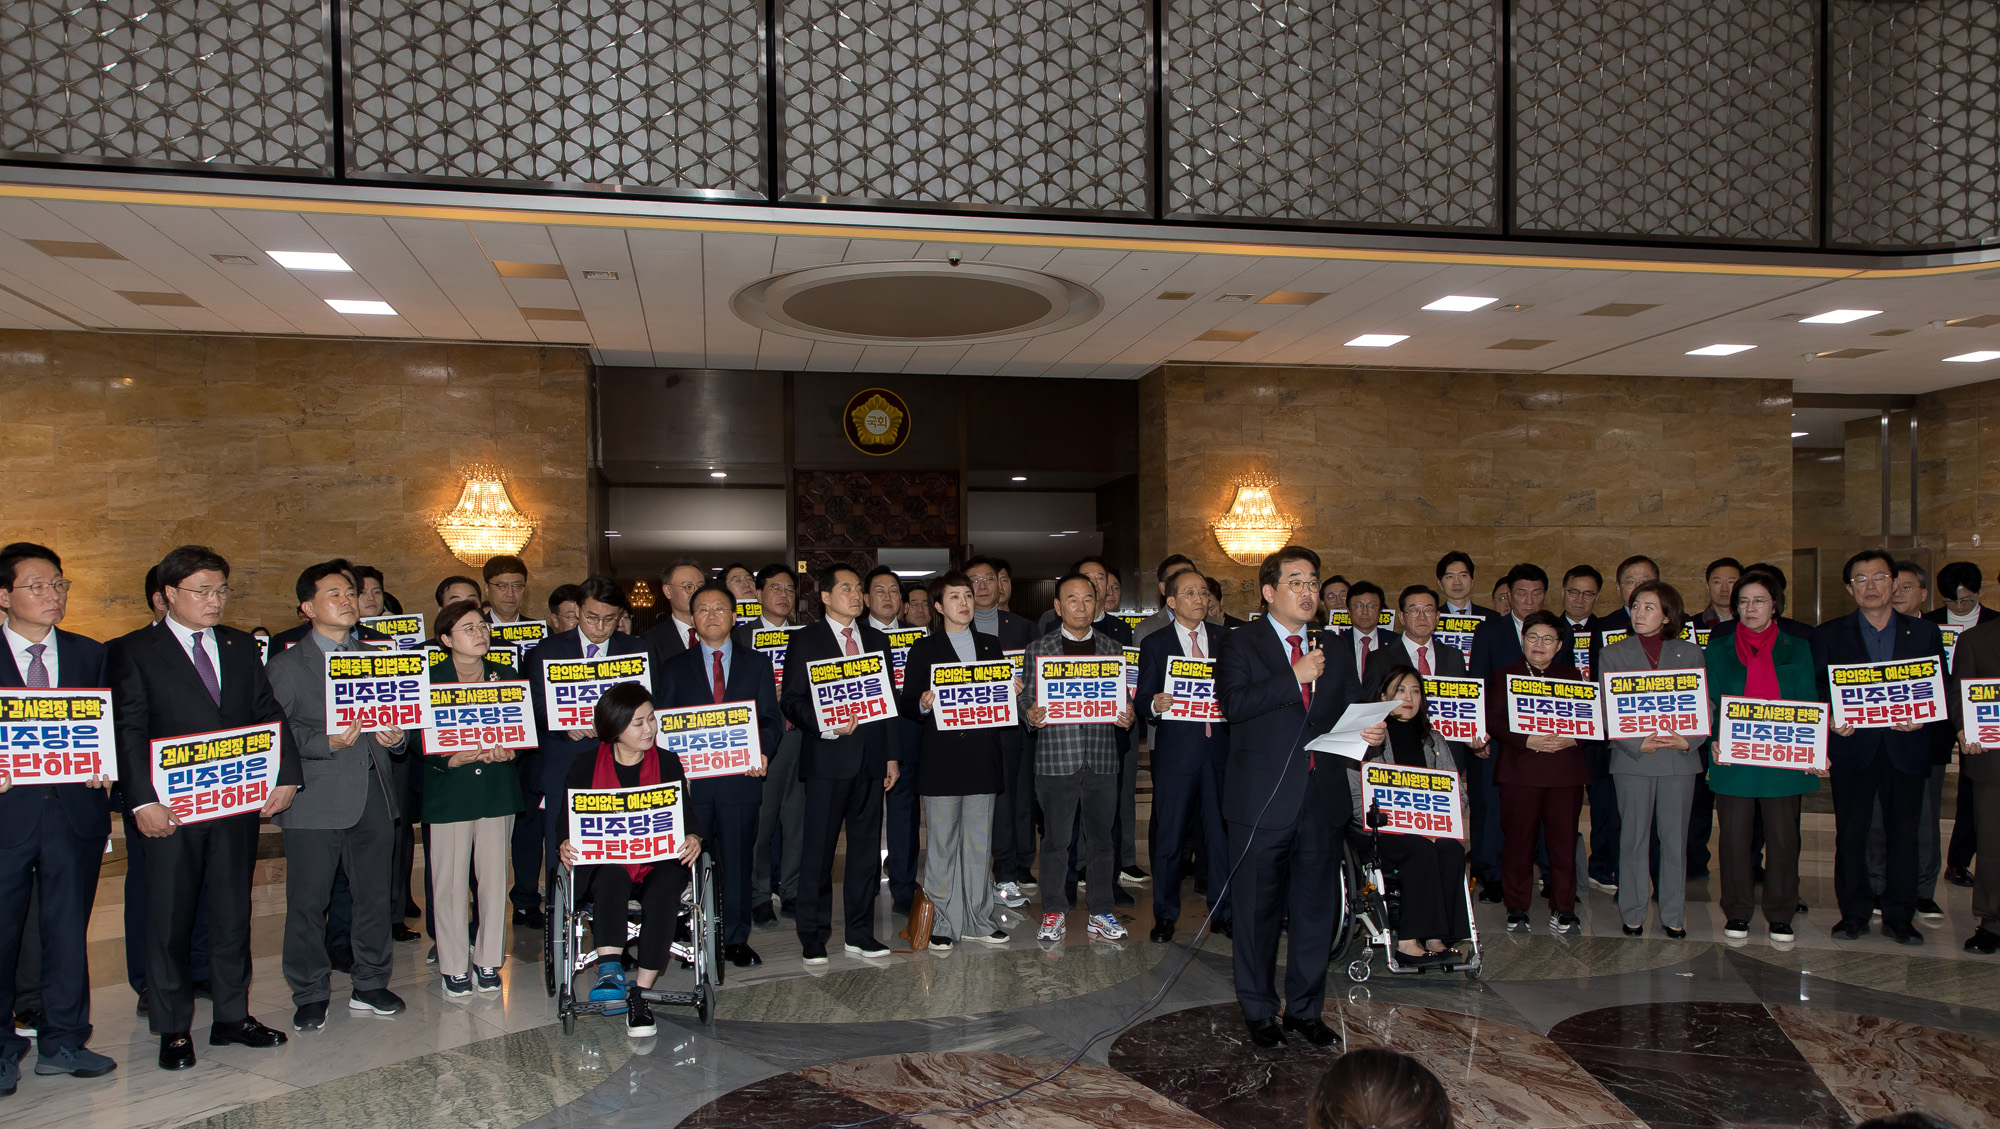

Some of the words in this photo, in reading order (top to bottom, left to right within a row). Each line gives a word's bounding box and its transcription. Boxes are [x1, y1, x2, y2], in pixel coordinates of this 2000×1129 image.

[867, 415, 888, 428] 국회
[376, 619, 418, 634] 예산폭주
[503, 626, 542, 639] 예산폭주
[756, 632, 789, 647] 합의없는
[1943, 632, 1954, 645] 핵
[330, 658, 372, 676] 탄핵중독
[374, 657, 422, 675] 입법폭주
[549, 664, 595, 680] 합의없는
[597, 659, 643, 677] 예산폭주
[811, 665, 842, 682] 합의없는
[843, 658, 880, 676] 예산폭주
[935, 668, 972, 684] 합의없는
[973, 665, 1011, 681] 예산폭주
[1044, 663, 1100, 677] 검사·감사원장
[1101, 662, 1119, 677] 탄핵
[1171, 661, 1213, 677] 합의없는
[1835, 668, 1882, 684] 합의없는
[1884, 662, 1934, 680] 예산폭주
[335, 680, 420, 705] 민주당은
[817, 678, 882, 706] 민주당을
[1047, 681, 1117, 699] 민주당은
[1440, 682, 1478, 697] 입법폭주
[1512, 679, 1552, 695] 합의없는
[1554, 684, 1594, 699] 예산폭주
[1612, 677, 1675, 692] 검사·감사원장
[1676, 675, 1698, 690] 탄핵
[1841, 681, 1934, 705] 민주당을
[430, 688, 498, 704] 검사·감사원장
[500, 687, 523, 701] 탄핵
[939, 685, 1009, 707] 민주당을
[1617, 694, 1696, 714] 민주당은
[71, 699, 101, 718] 탄핵
[336, 704, 422, 728] 각성하라
[434, 706, 523, 727] 민주당은
[821, 697, 887, 726] 규탄한다
[942, 705, 1011, 726] 규탄한다
[1048, 700, 1117, 718] 중단하라
[1427, 700, 1476, 719] 주당은
[1516, 697, 1593, 719] 민주당을
[1729, 704, 1795, 721] 검사·감사원장
[1797, 708, 1819, 723] 탄핵
[1844, 700, 1936, 724] 규탄한다
[662, 711, 726, 731] 검사·감사원장
[727, 708, 749, 724] 탄핵
[1430, 720, 1477, 738] 하라
[1518, 715, 1595, 736] 규탄한다
[1619, 713, 1698, 733] 중단하라
[437, 725, 526, 746] 중단하라
[667, 728, 748, 753] 민주당은
[1731, 722, 1815, 744] 민주당은
[162, 737, 244, 767] 검사·감사원장
[246, 732, 271, 753] 탄핵
[1731, 742, 1815, 764] 중단하라
[168, 757, 267, 794] 민주당은
[1369, 769, 1429, 789] 검사·감사원장
[1431, 776, 1451, 791] 탄핵
[169, 780, 268, 818] 중단하라
[574, 795, 624, 811] 합의없는
[627, 788, 675, 809] 예산폭주
[1374, 788, 1450, 813] 민주당은
[580, 811, 673, 836] 민주당을
[581, 834, 675, 860] 규탄한다
